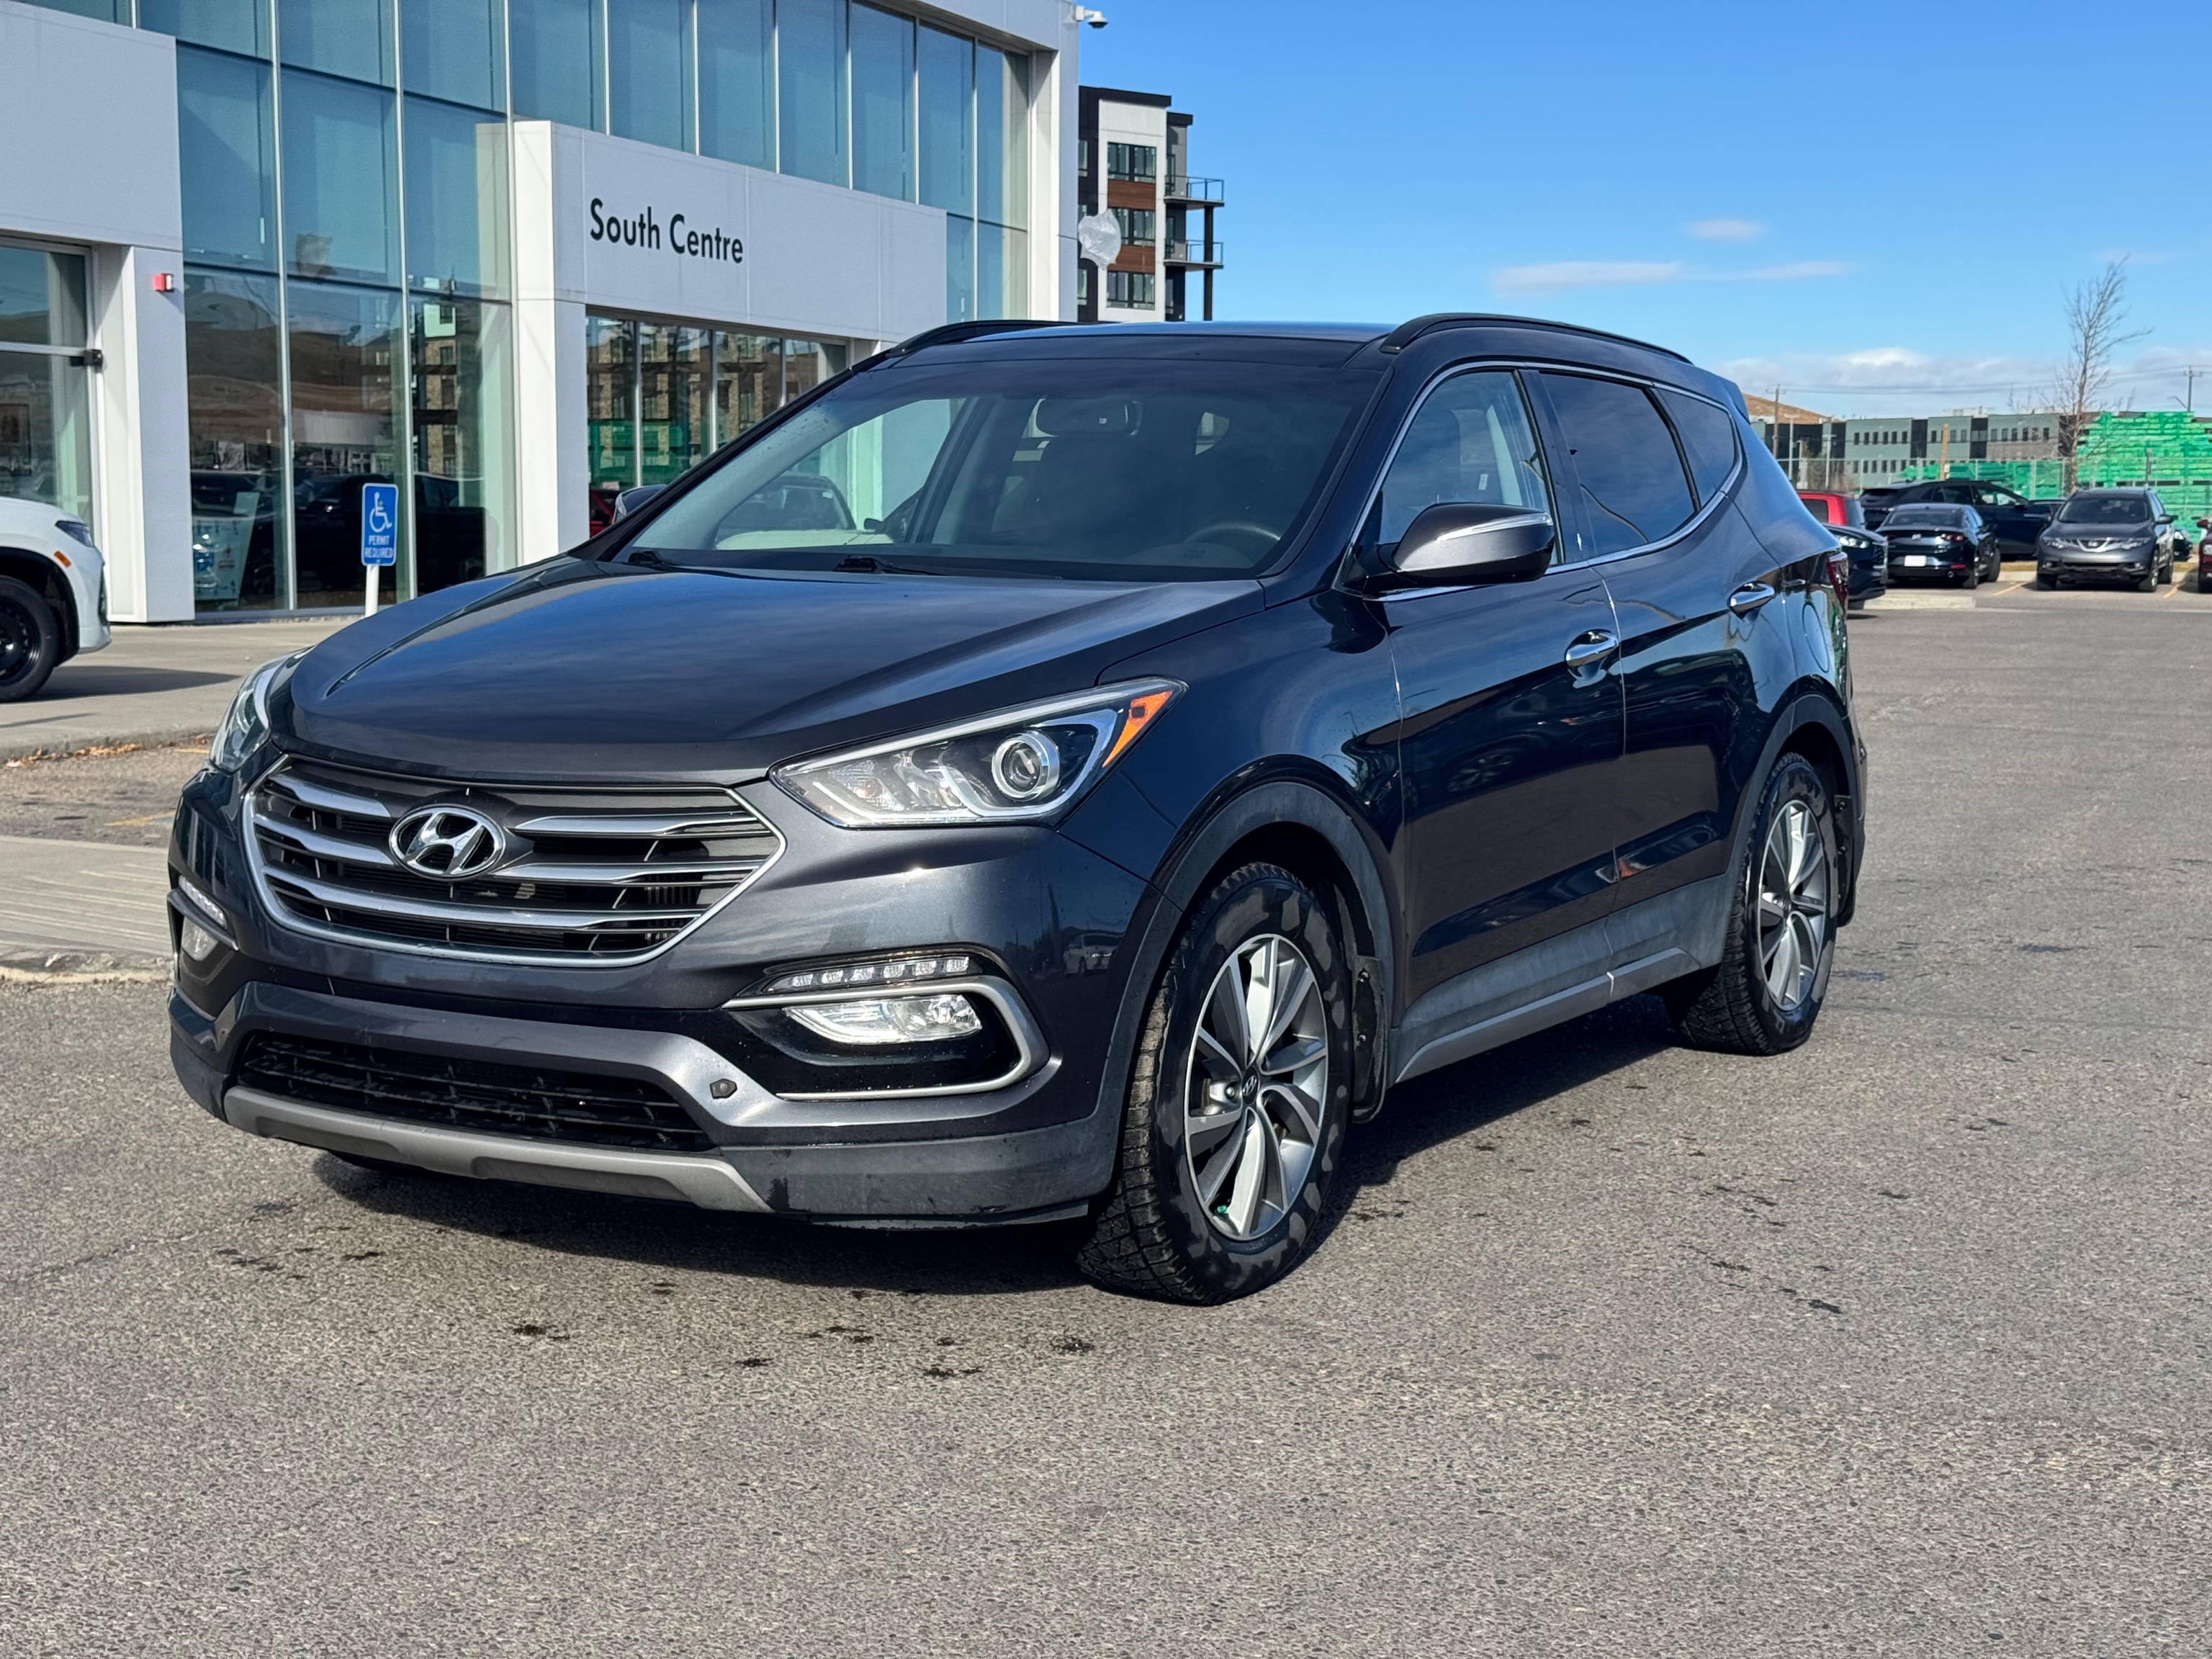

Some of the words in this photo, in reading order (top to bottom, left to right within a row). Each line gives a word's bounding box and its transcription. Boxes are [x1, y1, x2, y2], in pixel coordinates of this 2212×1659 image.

[590, 197, 660, 250] South
[670, 213, 743, 264] Centre
[368, 535, 390, 546] PERMIT
[364, 547, 394, 559] REQUIRED
